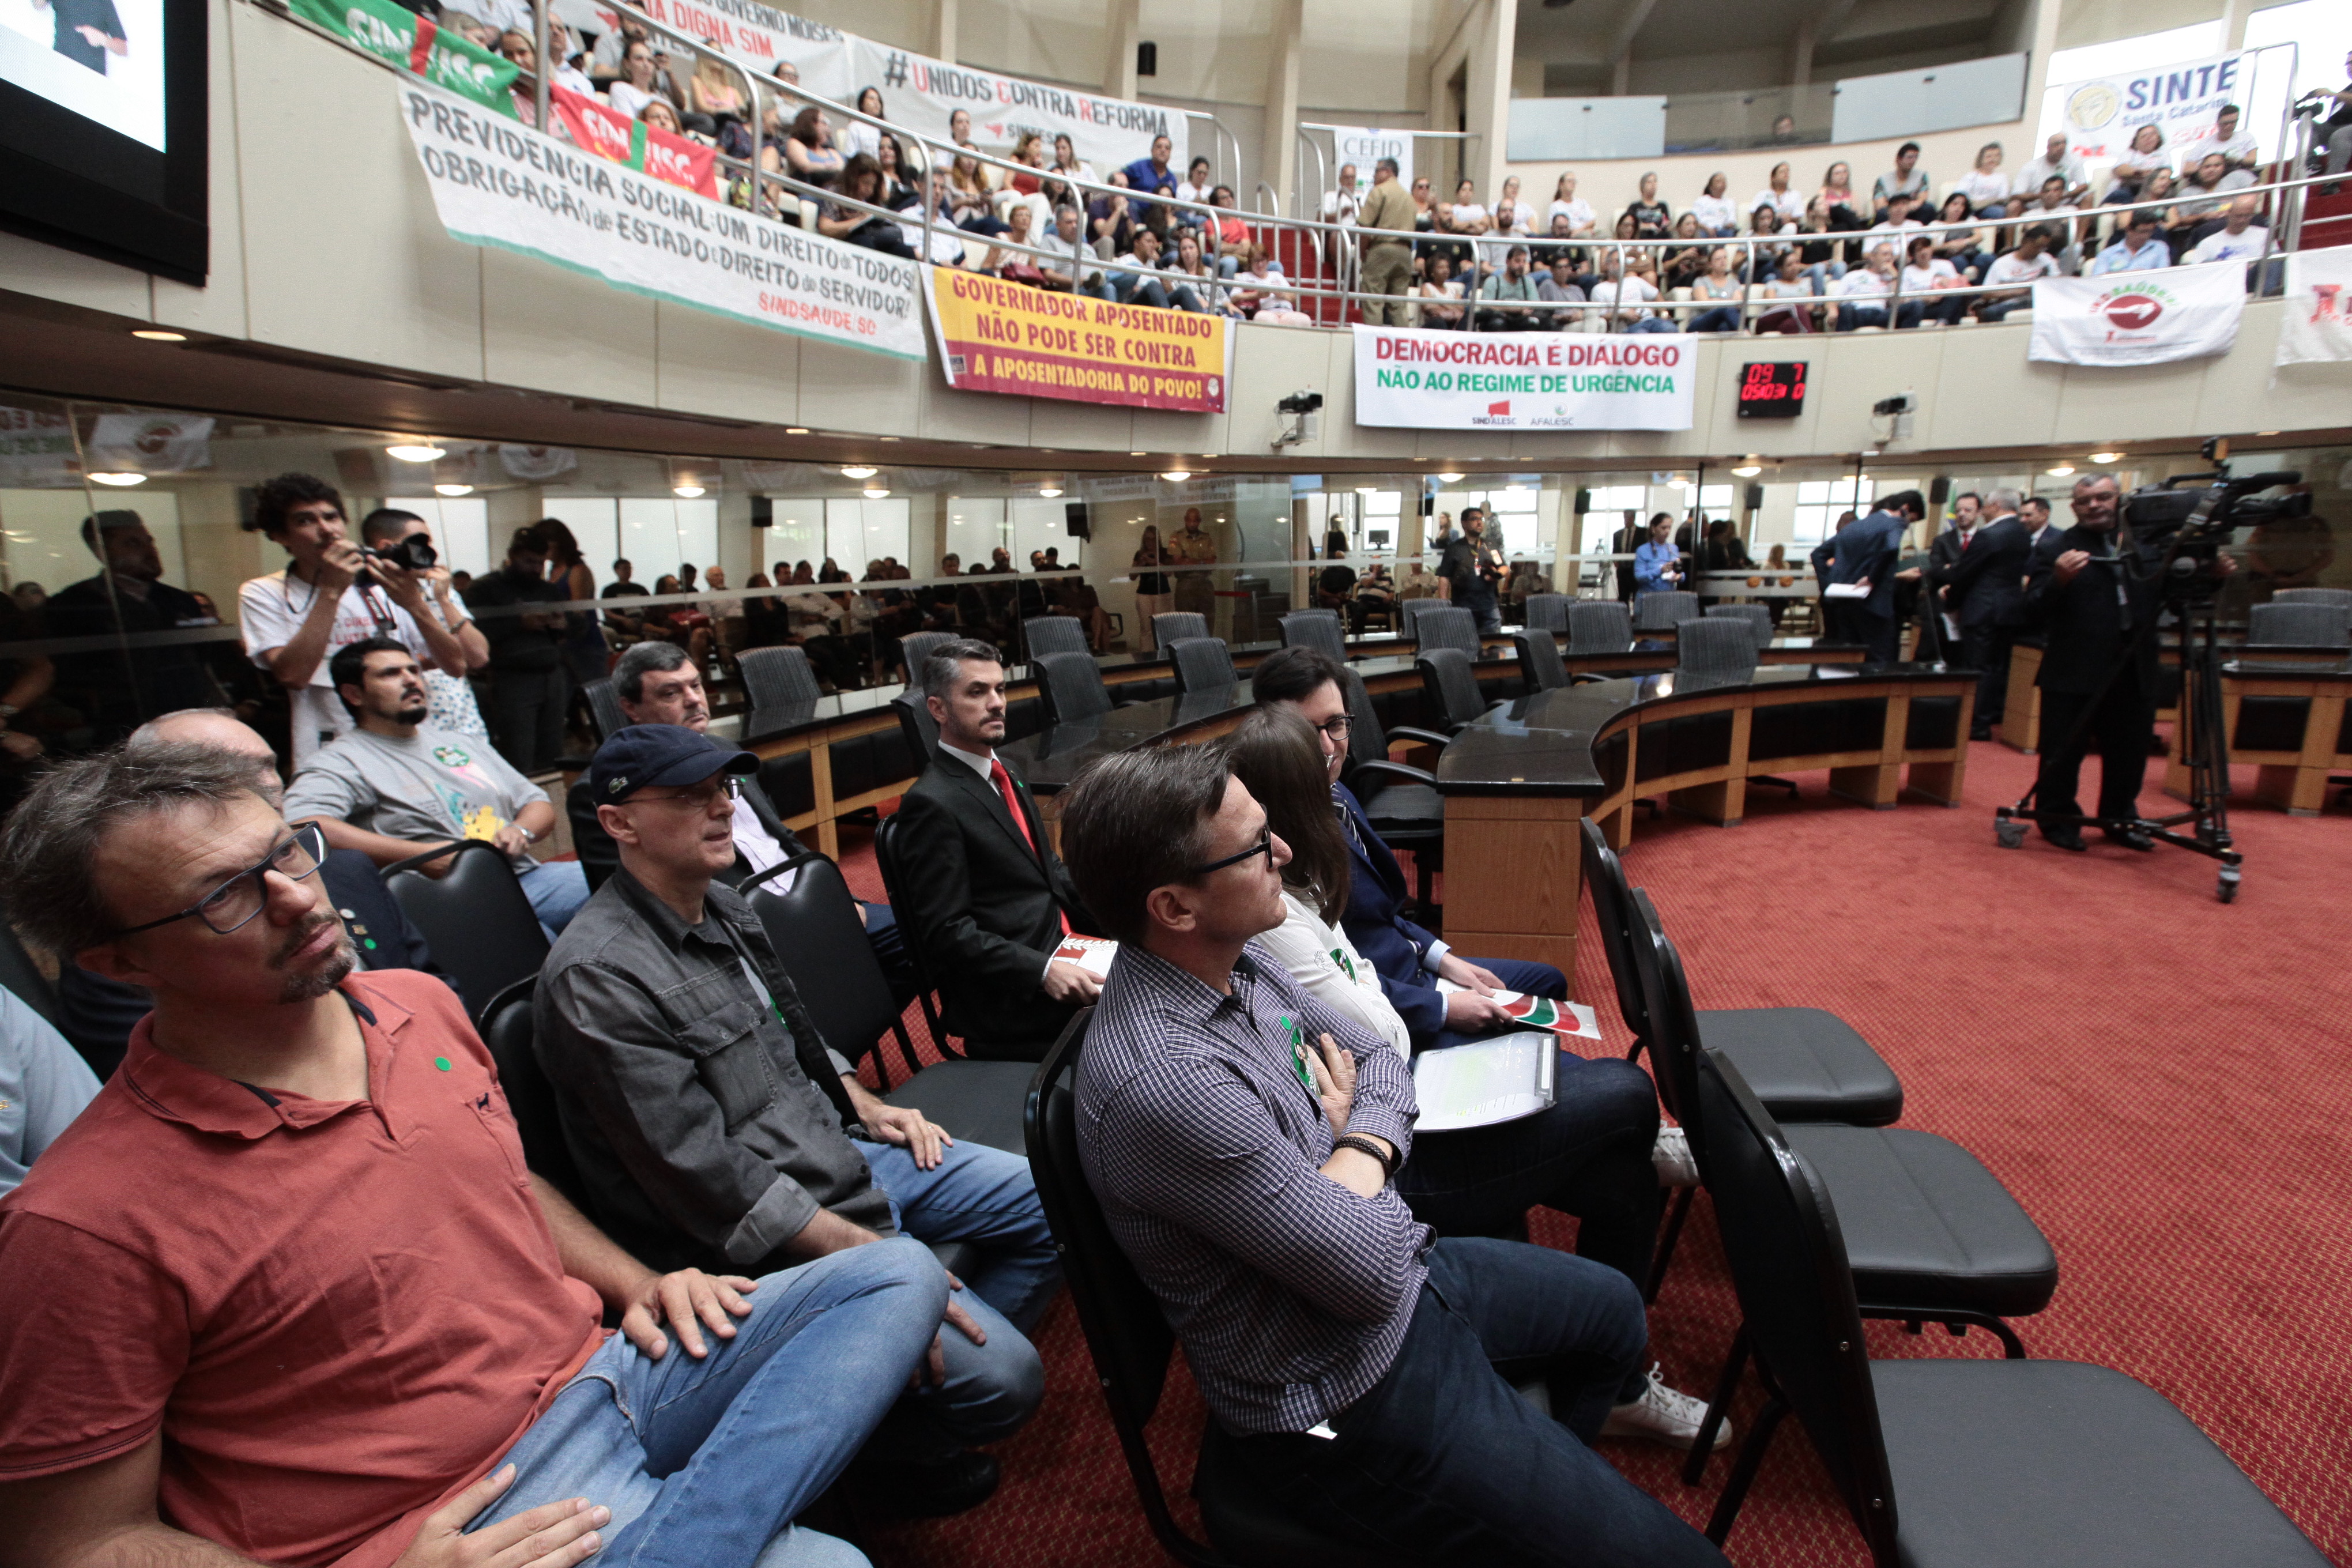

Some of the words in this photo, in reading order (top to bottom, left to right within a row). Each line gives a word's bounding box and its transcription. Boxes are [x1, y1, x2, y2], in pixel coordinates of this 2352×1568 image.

[673, 1, 734, 47] DIGNA
[738, 27, 774, 58] SIM
[997, 81, 1076, 119] CONTRA
[1079, 97, 1170, 138] REFORMA
[2127, 58, 2240, 110] SINTE
[407, 92, 615, 199] PREVIDÊNCIA
[716, 212, 750, 244] UM
[757, 224, 838, 269] DIREITO
[852, 254, 915, 291] TODOS
[424, 144, 590, 226] OBRIGAÇÃO
[616, 210, 708, 262] ESTADO
[719, 245, 799, 290] DIREITO
[819, 276, 911, 319] SERVIDOR!
[952, 273, 1087, 322] GOVERNADOR
[1095, 301, 1212, 339] APOSENTADO
[977, 310, 1020, 344] NÃO
[1028, 325, 1078, 353] PODE
[1085, 334, 1117, 359] SER
[1124, 338, 1196, 367] CONTRA
[1376, 336, 1540, 365] DEMOCRACIA
[1547, 338, 1562, 365] É
[1569, 338, 1680, 367] DIÁLOGO
[974, 353, 987, 376] A
[993, 354, 1125, 392] APOSENTADORIA
[1129, 374, 1149, 395] DO
[1155, 376, 1203, 399] POVO!
[1377, 364, 1420, 390] NÃO
[1424, 371, 1453, 390] AO
[1457, 372, 1536, 393] REGIME
[1540, 374, 1567, 393] DE
[1572, 369, 1675, 393] URGÊNCIA
[1530, 417, 1574, 426] AFALESC
